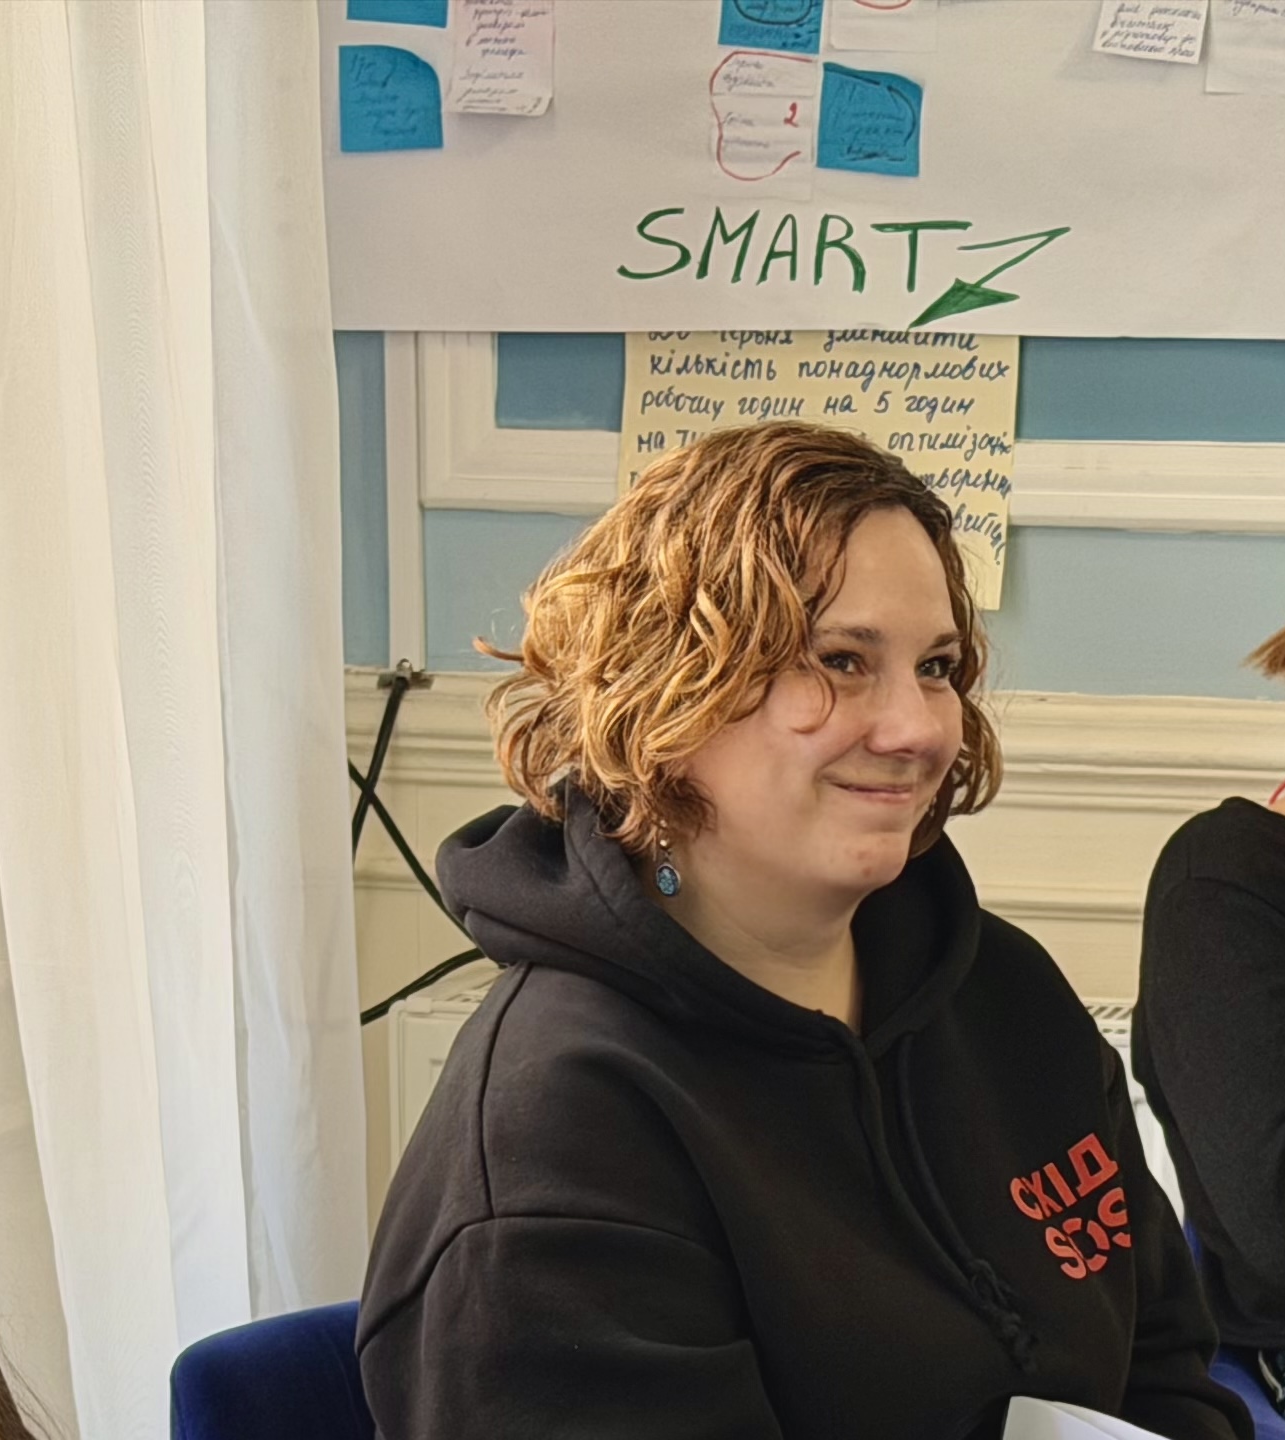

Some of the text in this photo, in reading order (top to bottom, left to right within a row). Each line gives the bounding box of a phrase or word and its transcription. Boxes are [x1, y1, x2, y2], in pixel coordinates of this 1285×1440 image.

[615, 205, 974, 294] SMART
[649, 348, 1011, 392] кількість понаднормових
[737, 394, 806, 420] годин
[822, 394, 859, 416] на
[873, 390, 893, 414] 5
[904, 394, 976, 424] годин
[636, 430, 666, 454] на
[1009, 1132, 1119, 1221] СХІД
